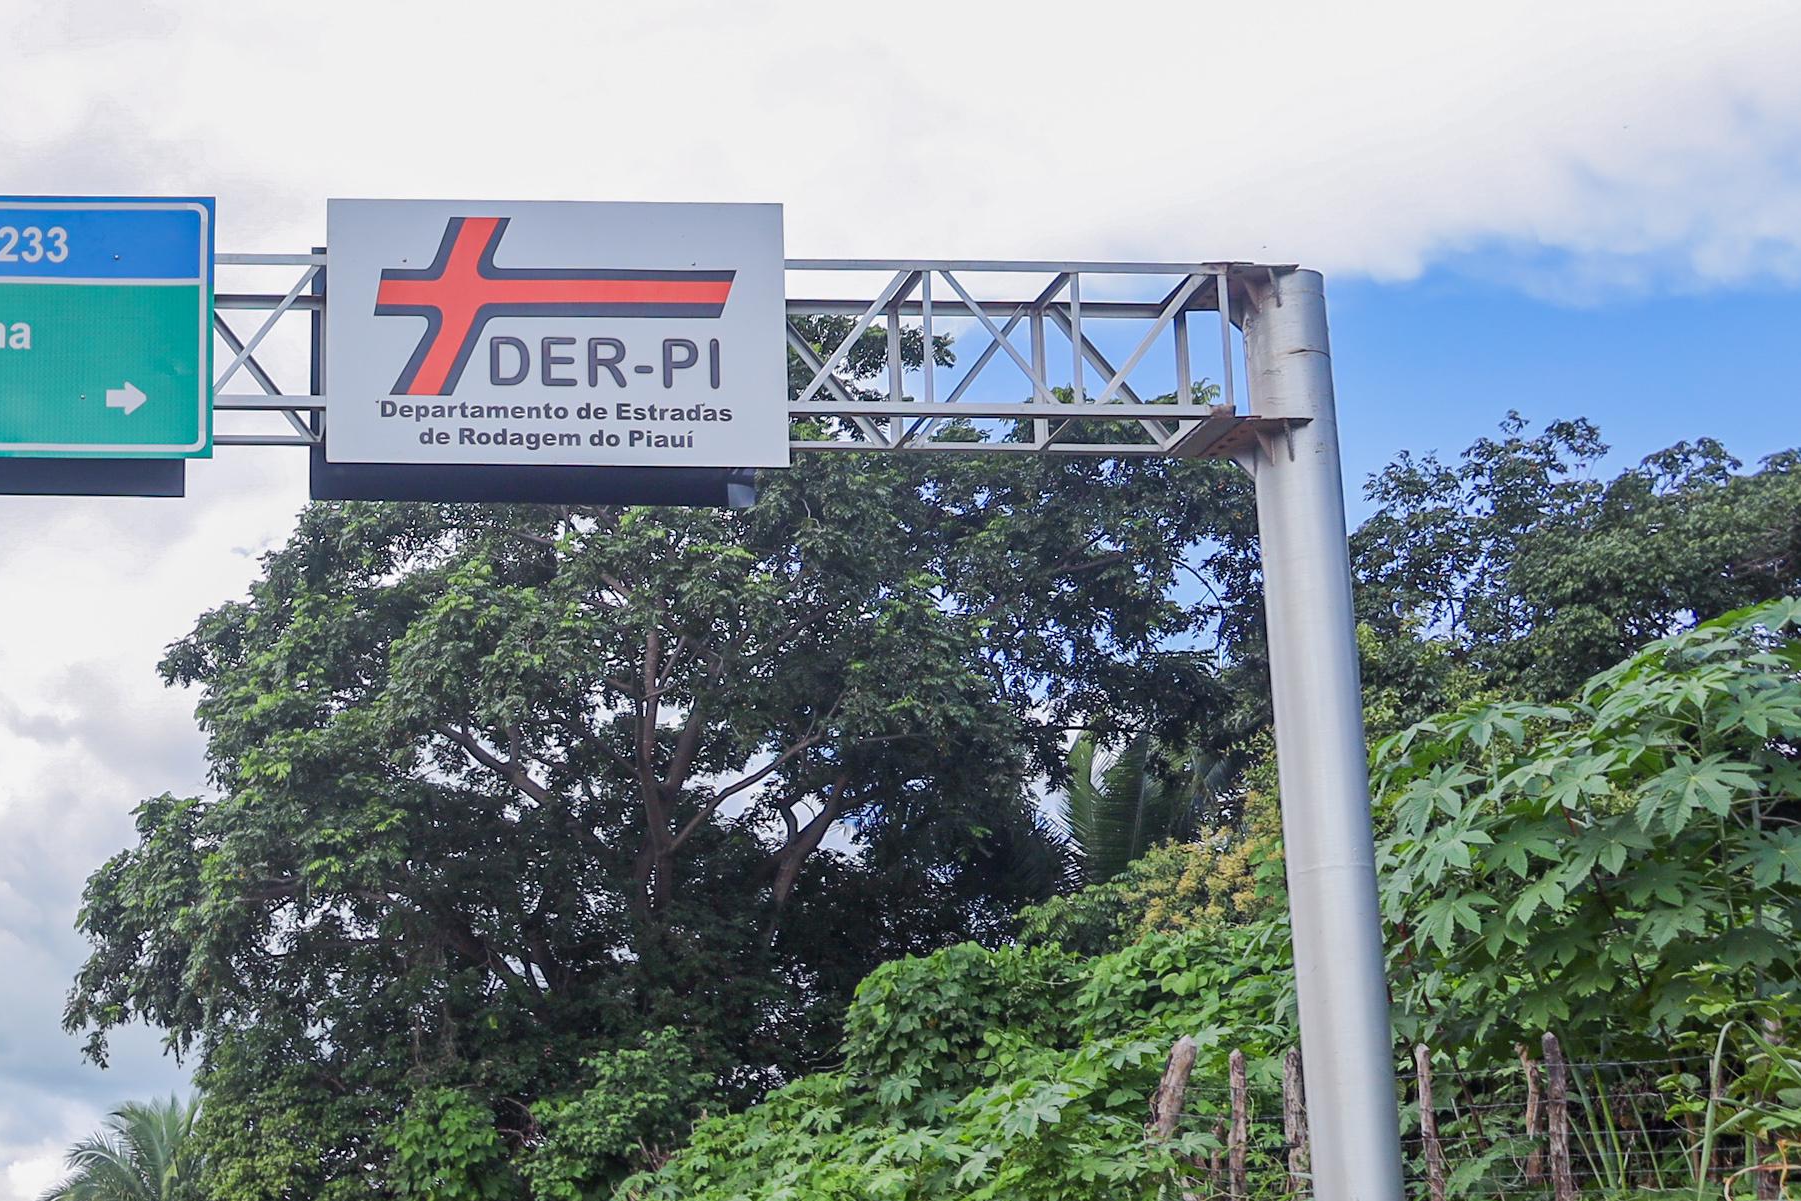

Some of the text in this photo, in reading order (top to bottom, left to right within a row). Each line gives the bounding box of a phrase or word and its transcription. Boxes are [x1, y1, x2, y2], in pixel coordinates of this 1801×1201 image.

[489, 336, 721, 390] DER-PI
[380, 400, 733, 422] Departamento de Estradas
[419, 427, 694, 451] de Rodagem do Piauí
